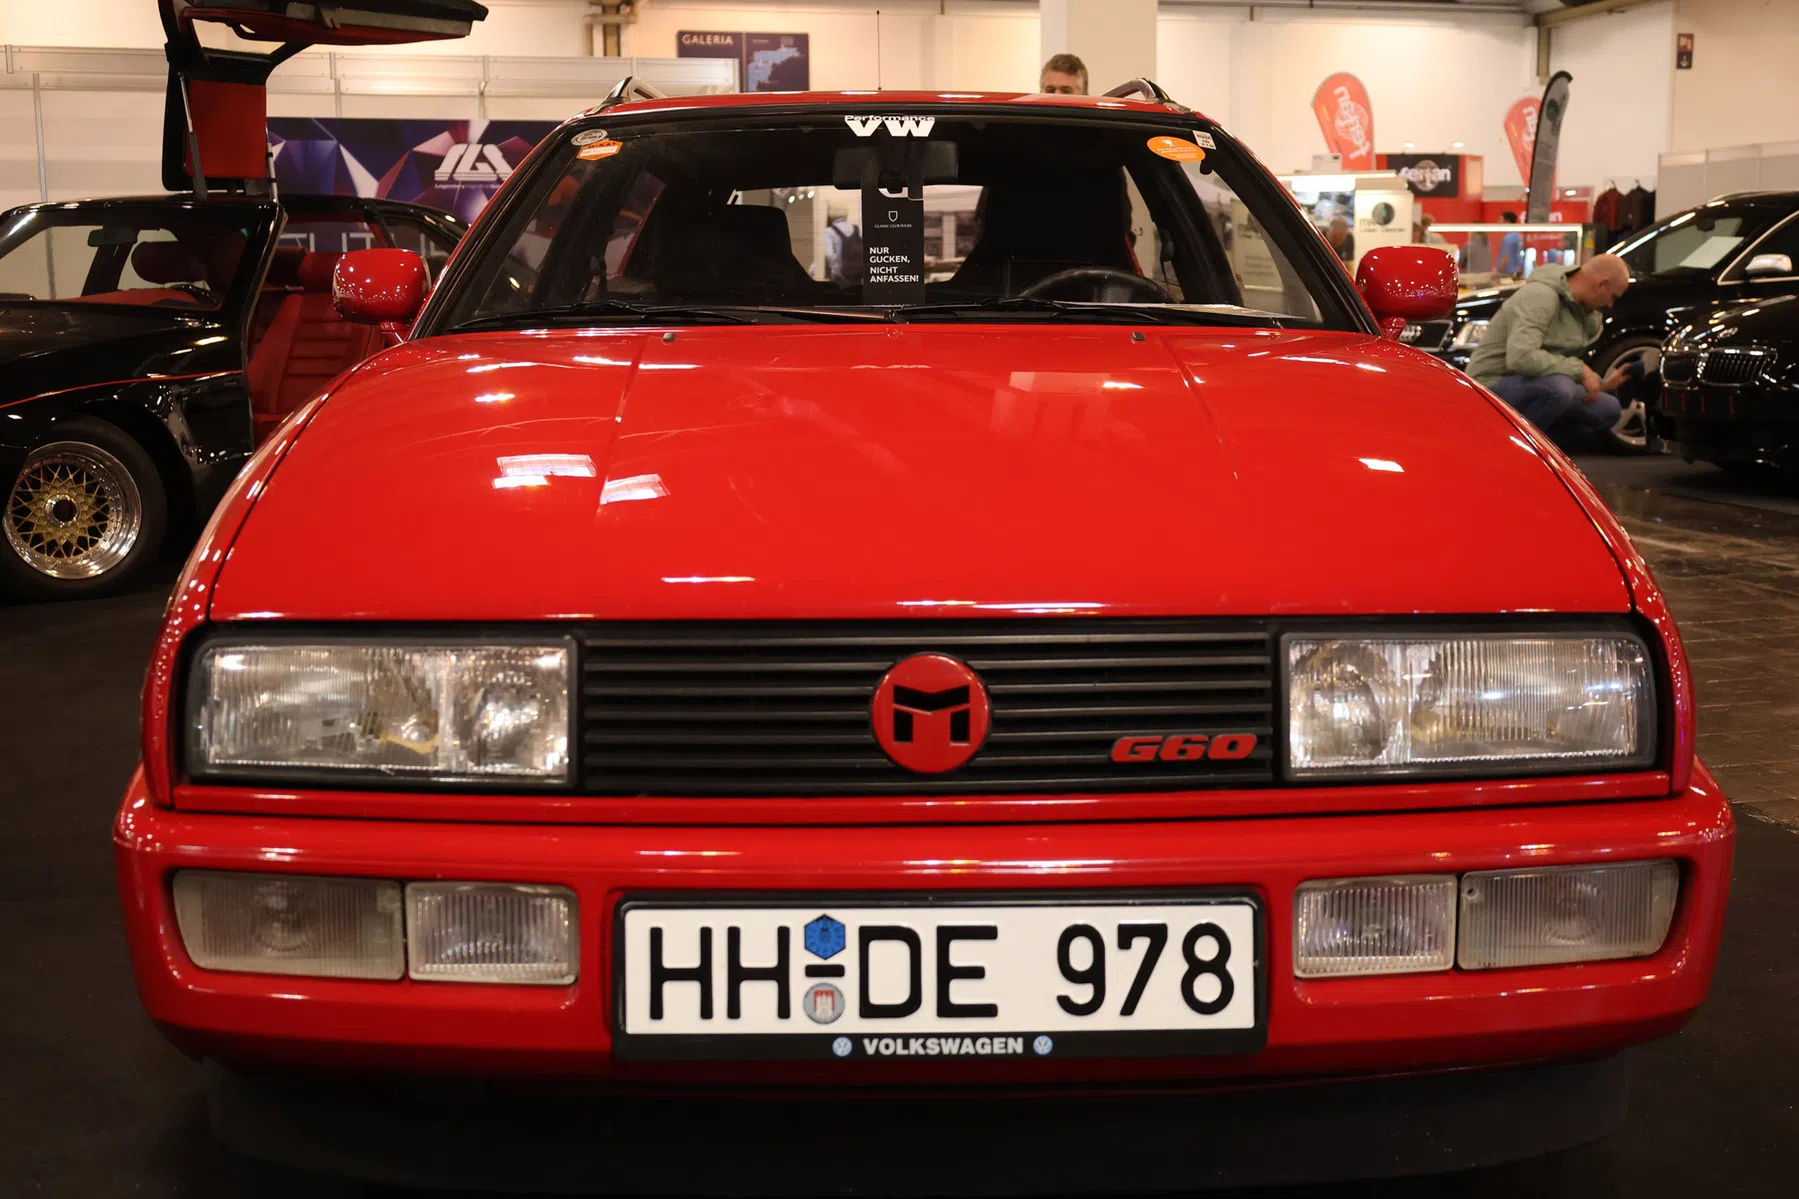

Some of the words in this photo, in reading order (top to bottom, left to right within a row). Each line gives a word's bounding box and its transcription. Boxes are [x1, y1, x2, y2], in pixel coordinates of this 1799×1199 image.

[681, 34, 734, 46] GALERIA
[845, 120, 936, 137] VW
[869, 247, 890, 255] NUR
[869, 255, 911, 264] GUCKEN,
[869, 266, 899, 275] NICHT
[869, 275, 920, 283] ANFASSEN!
[1109, 732, 1259, 763] G60
[1056, 922, 1235, 1017] 978
[862, 1037, 1024, 1056] VOLKSWAGEN
